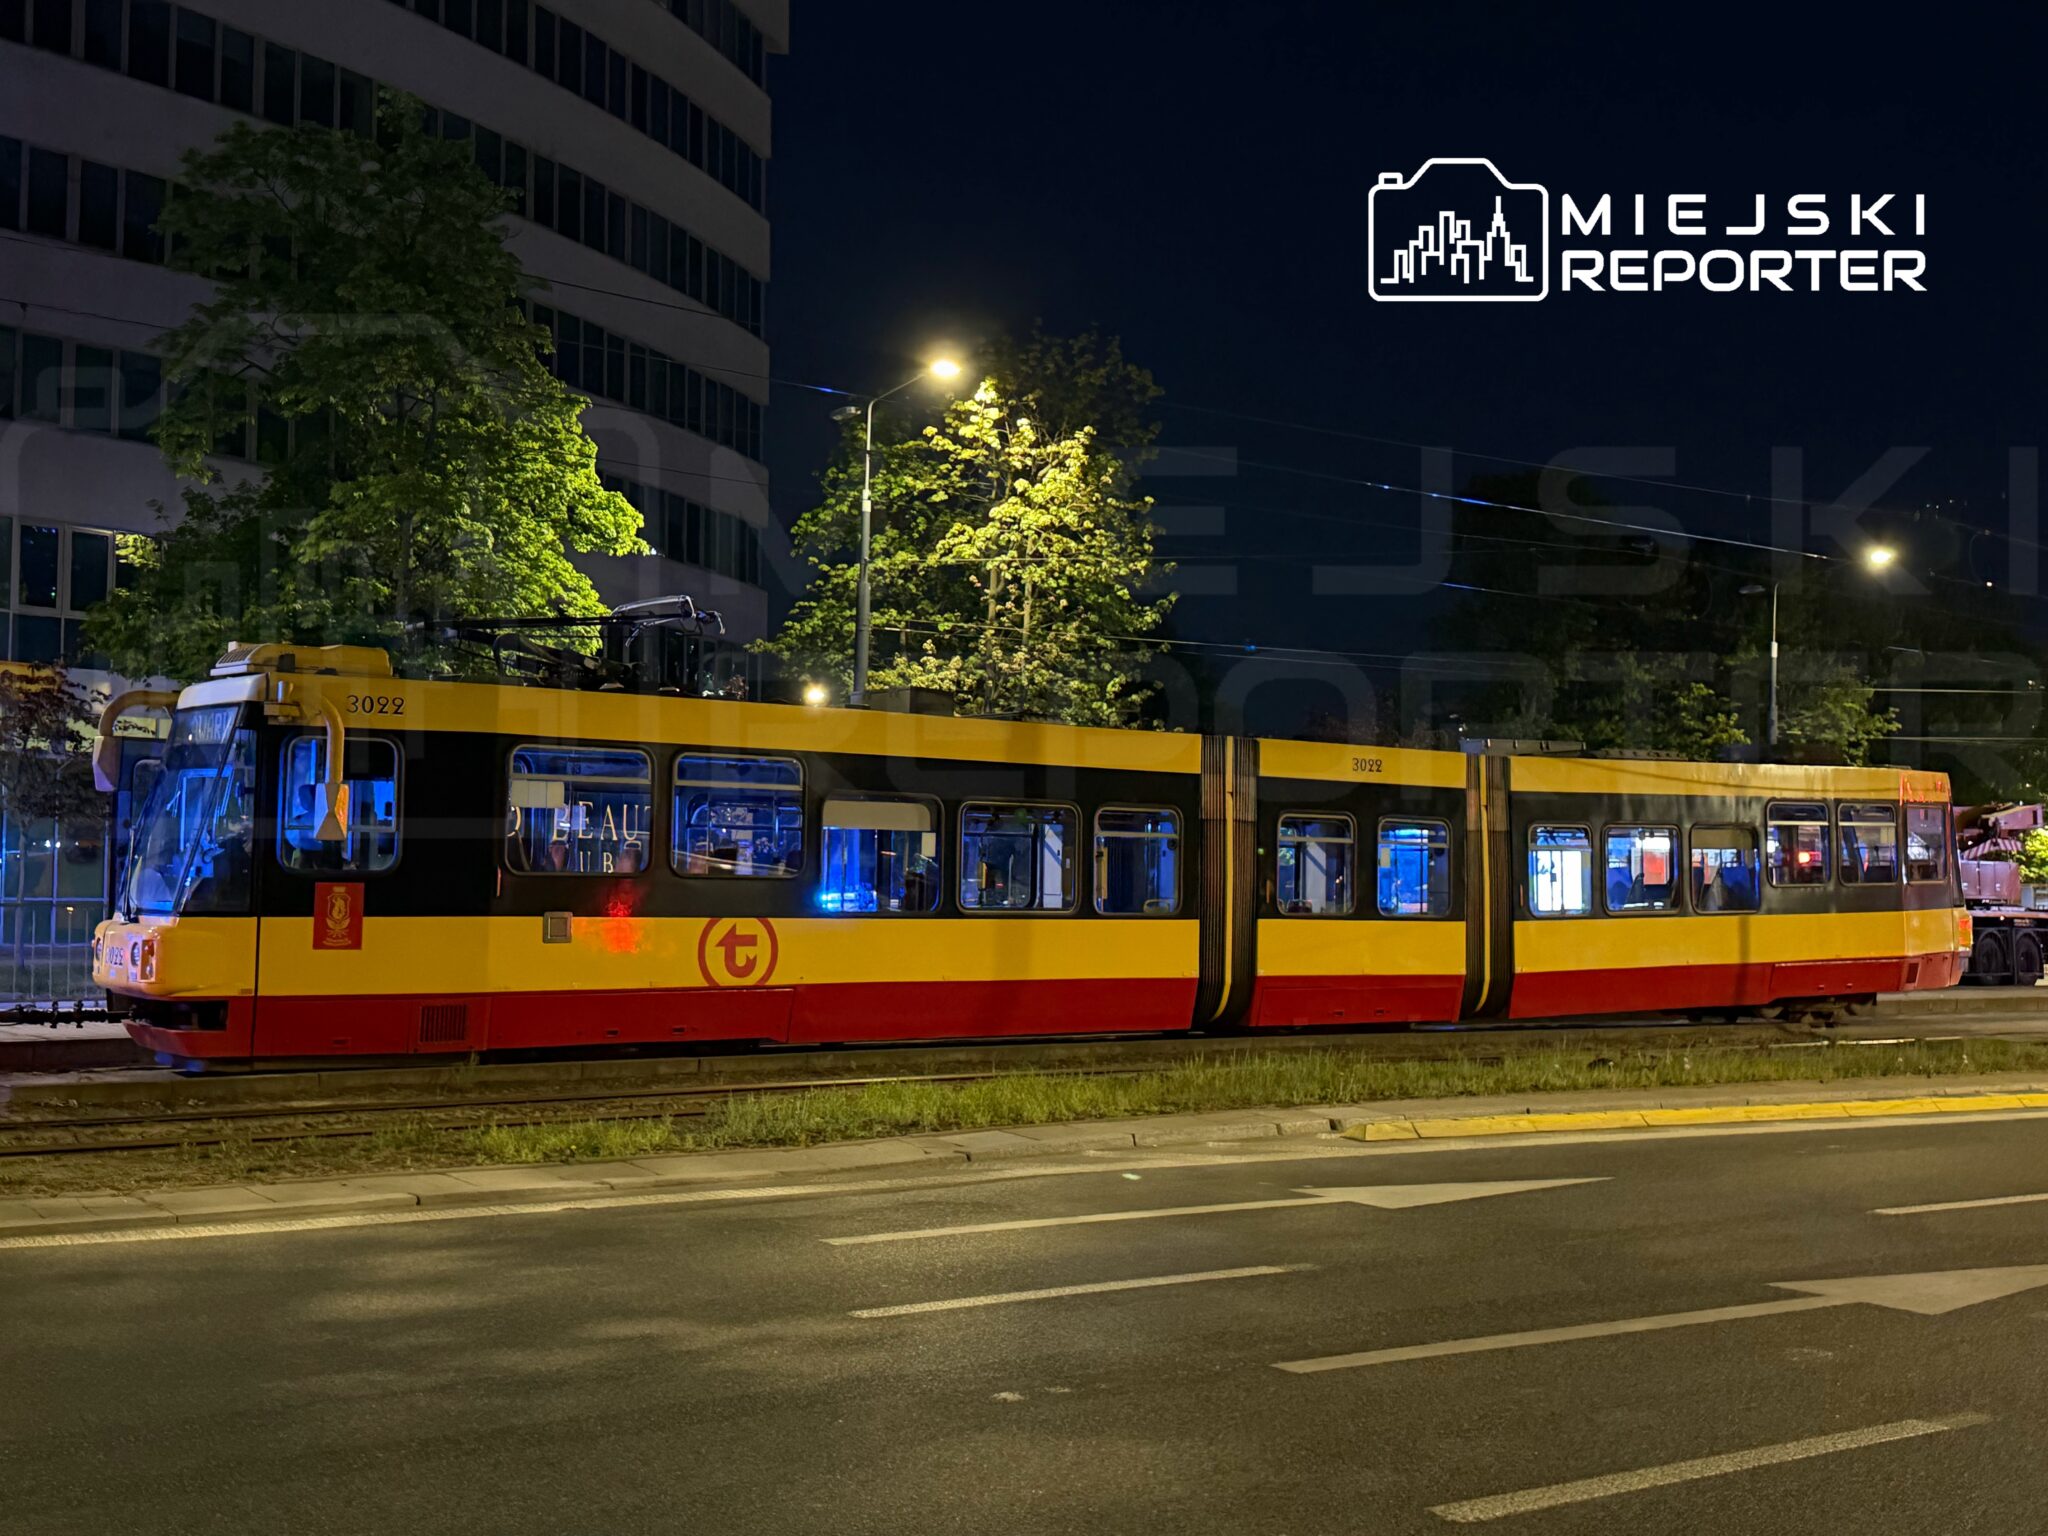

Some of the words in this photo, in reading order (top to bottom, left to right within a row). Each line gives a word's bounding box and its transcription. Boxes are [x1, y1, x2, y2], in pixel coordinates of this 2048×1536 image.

[346, 694, 405, 715] 3022
[1352, 757, 1382, 773] 3022
[552, 801, 651, 841] BEAU
